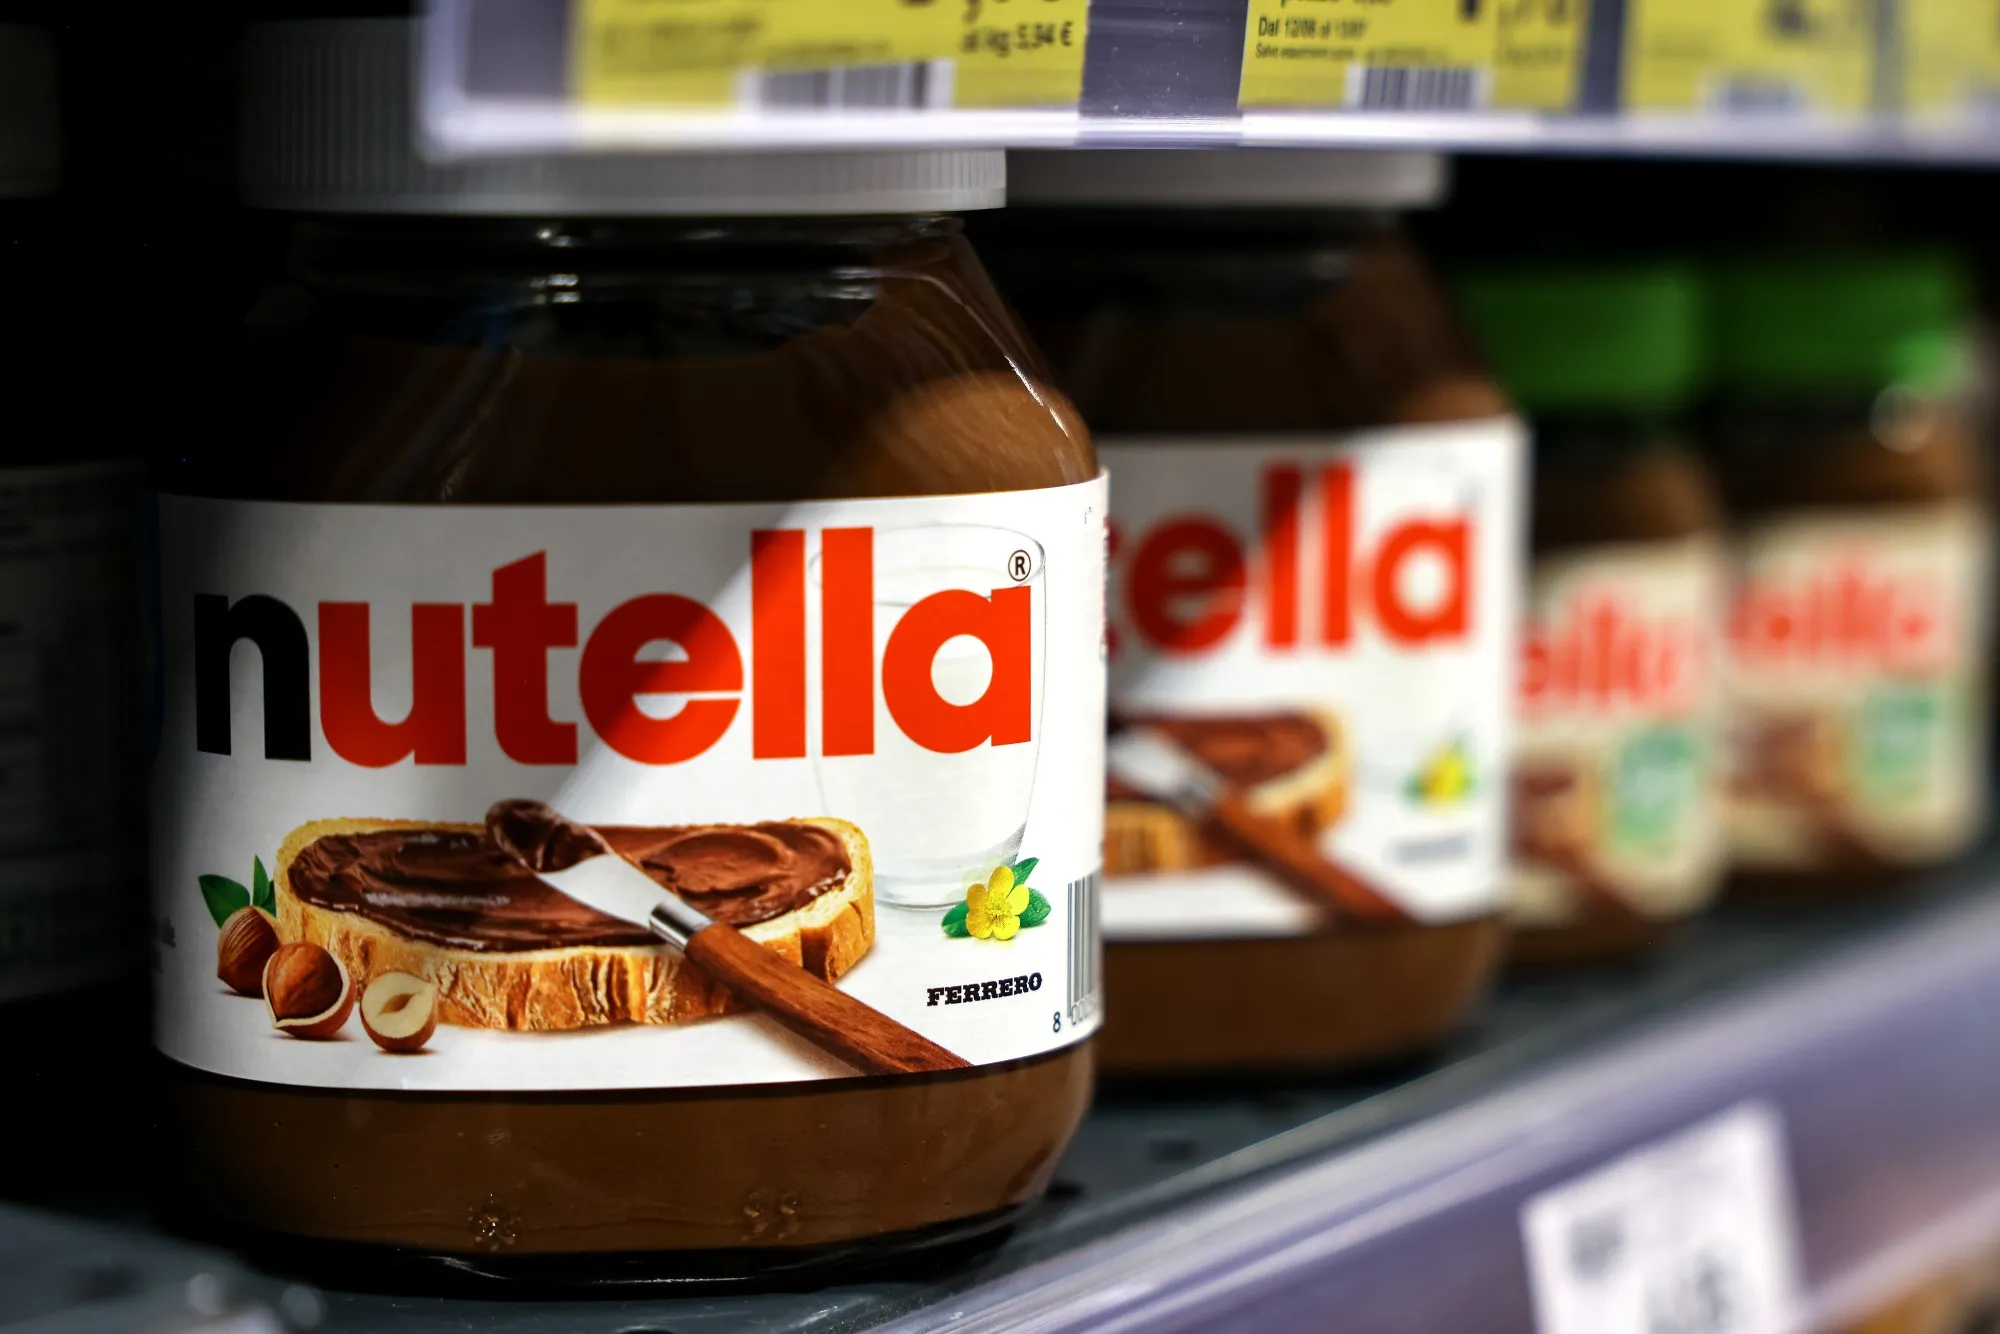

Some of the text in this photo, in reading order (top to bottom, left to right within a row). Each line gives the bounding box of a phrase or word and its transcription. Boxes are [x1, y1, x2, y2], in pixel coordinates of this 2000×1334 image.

[1060, 20, 1073, 47] €
[1258, 17, 1279, 37] Dal
[1108, 460, 1472, 662] ella
[194, 526, 1031, 768] nutella
[927, 972, 1042, 1006] FERRERO
